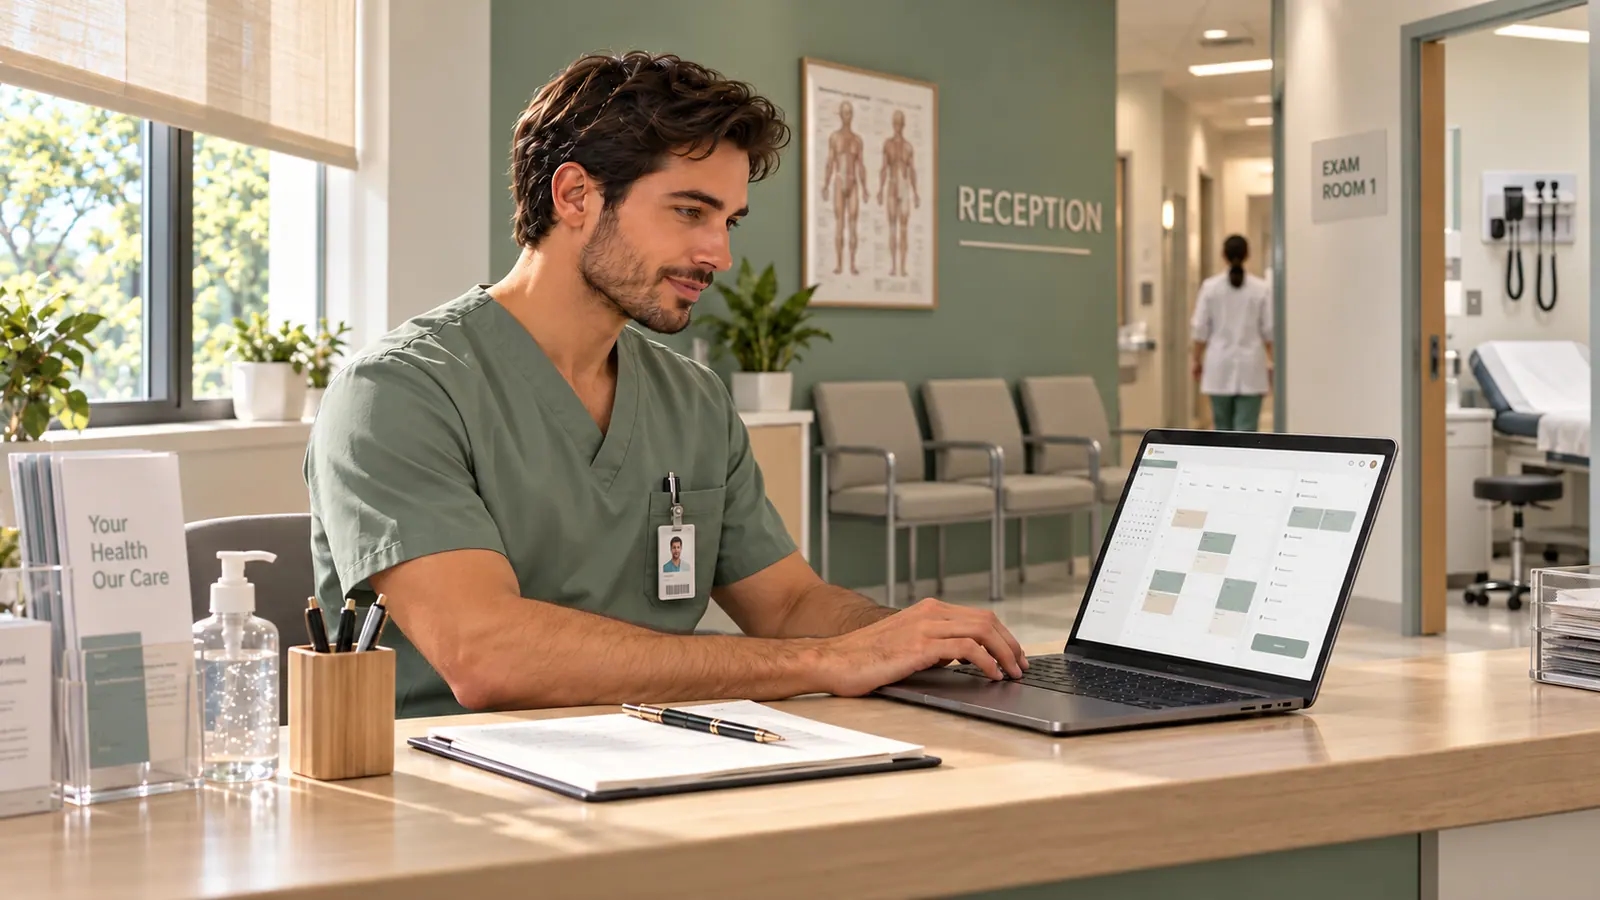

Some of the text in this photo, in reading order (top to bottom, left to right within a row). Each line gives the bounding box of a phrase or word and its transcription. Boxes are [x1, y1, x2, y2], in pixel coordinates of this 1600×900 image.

[1322, 156, 1360, 176] EXAM
[1322, 178, 1376, 200] ROOM 1
[959, 185, 1102, 233] RECEPTION
[88, 515, 128, 534] Your
[91, 540, 148, 562] Health
[92, 568, 169, 590] Our Care
